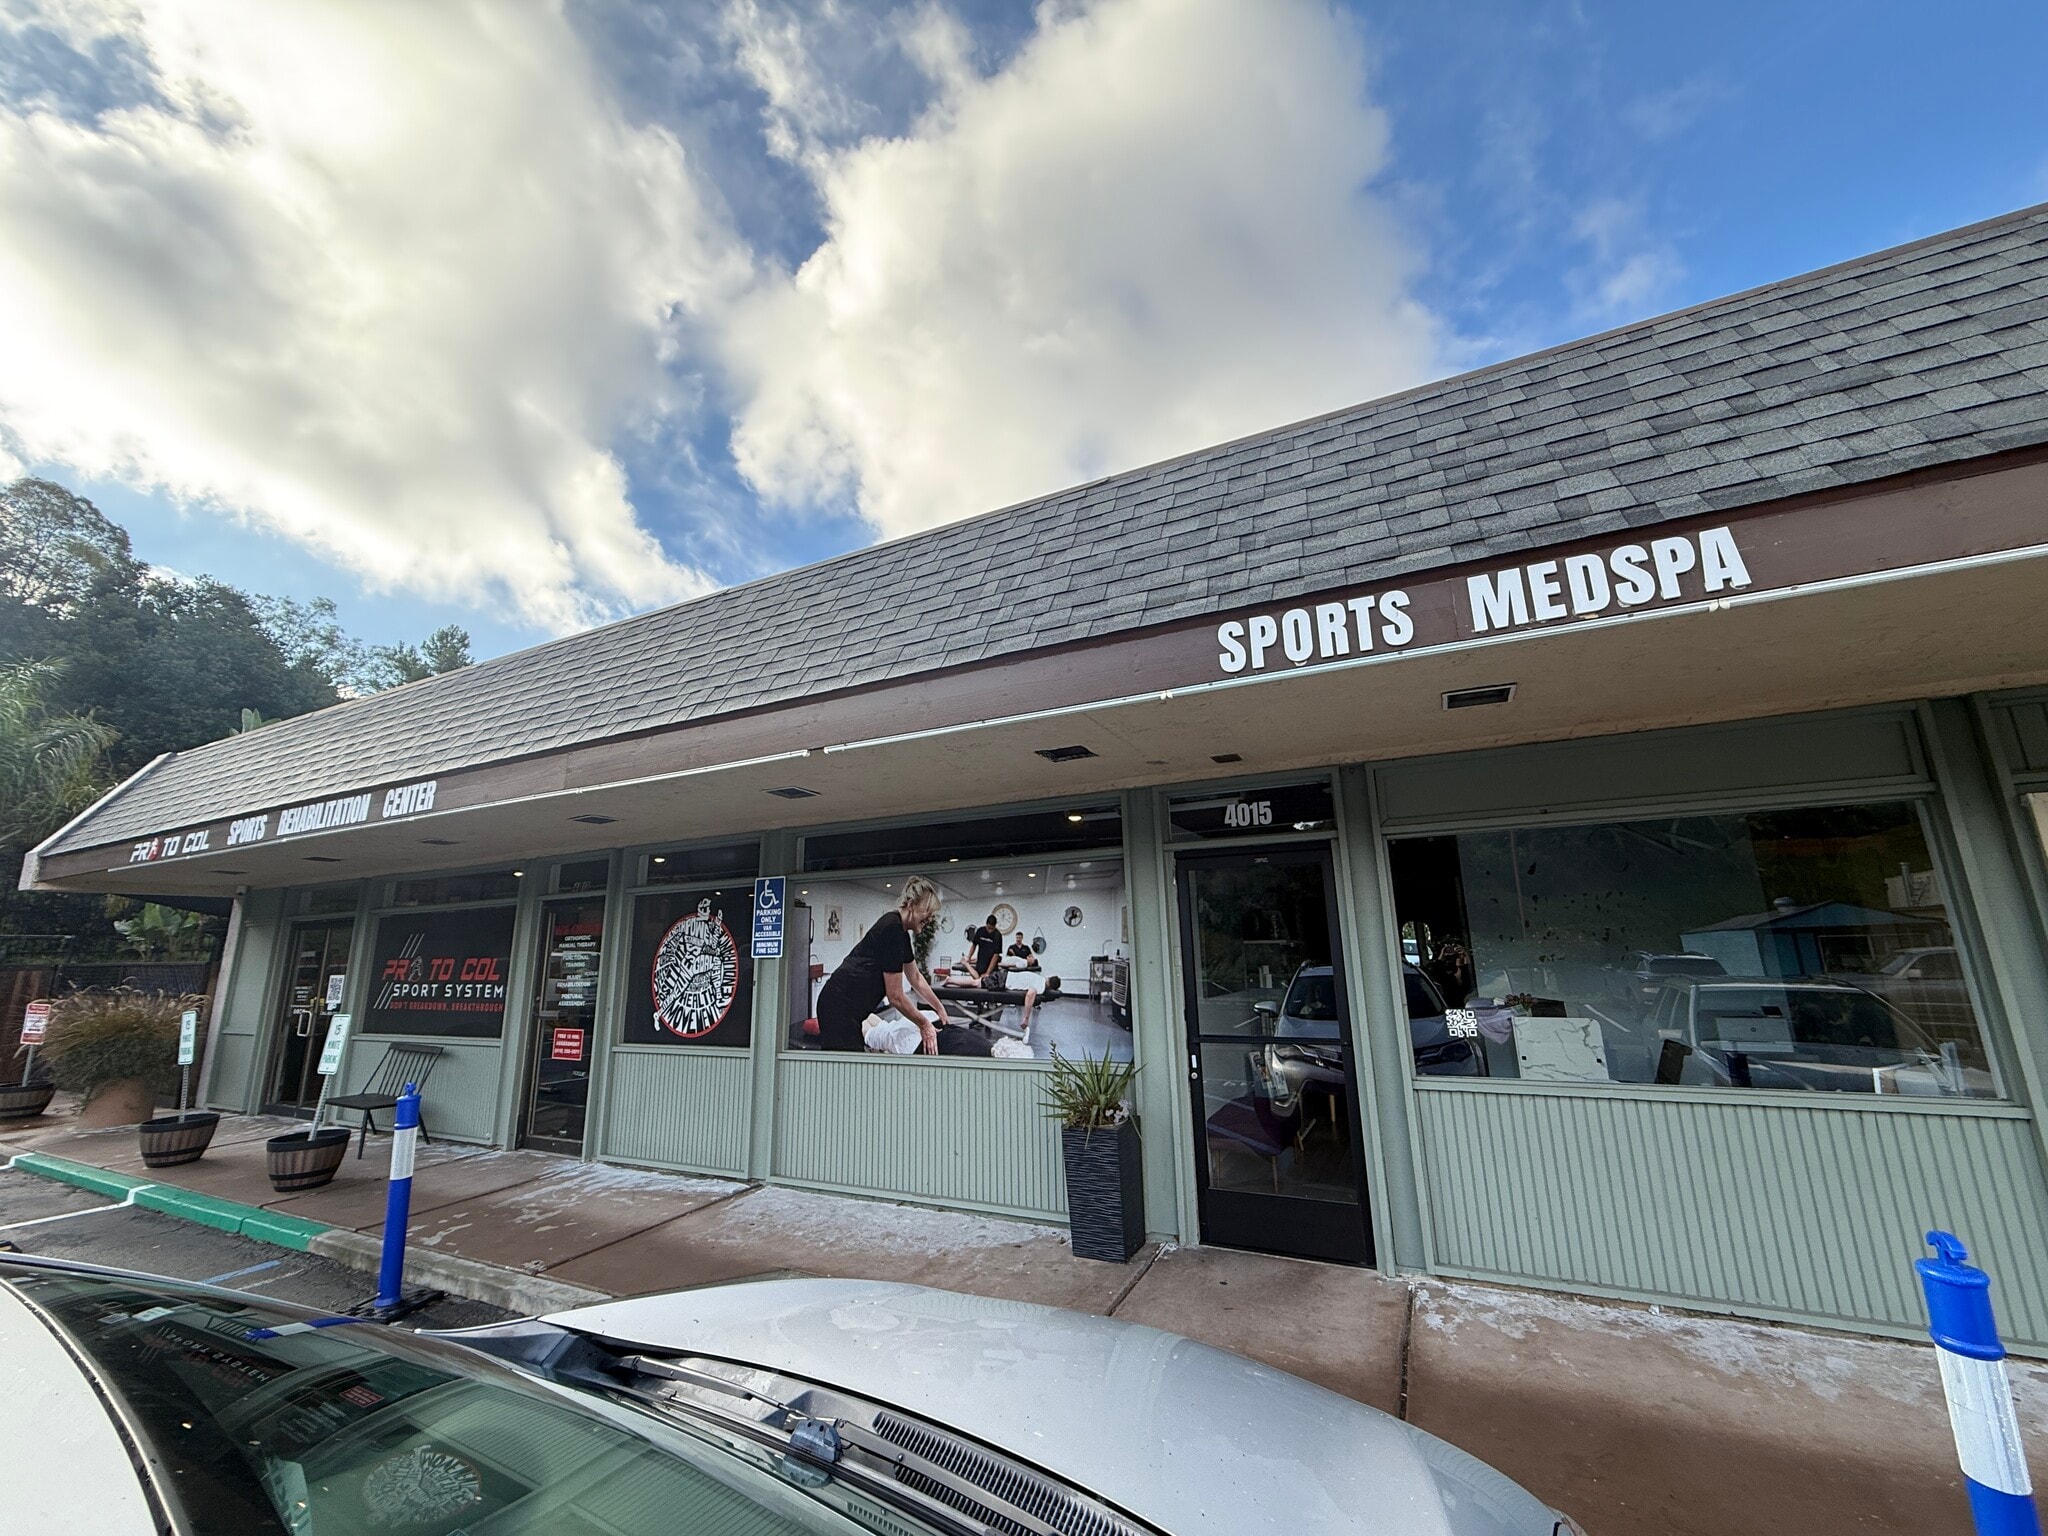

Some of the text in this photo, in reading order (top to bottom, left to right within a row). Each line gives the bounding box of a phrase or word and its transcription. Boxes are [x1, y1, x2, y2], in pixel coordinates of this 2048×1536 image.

[1217, 526, 1752, 674] SPORTS MEDSPA
[161, 836, 181, 857] TO
[182, 830, 210, 854] COL
[227, 814, 268, 846] SPORTS
[276, 793, 372, 836] REHABILITATION
[382, 780, 437, 819] CENTER
[1224, 801, 1273, 827] 4015
[429, 958, 456, 981] TO
[460, 957, 500, 981] COL
[392, 984, 504, 998] SPORT SYSTEM
[679, 986, 716, 1009] HEALTH
[661, 1003, 723, 1034] MOVEMENT
